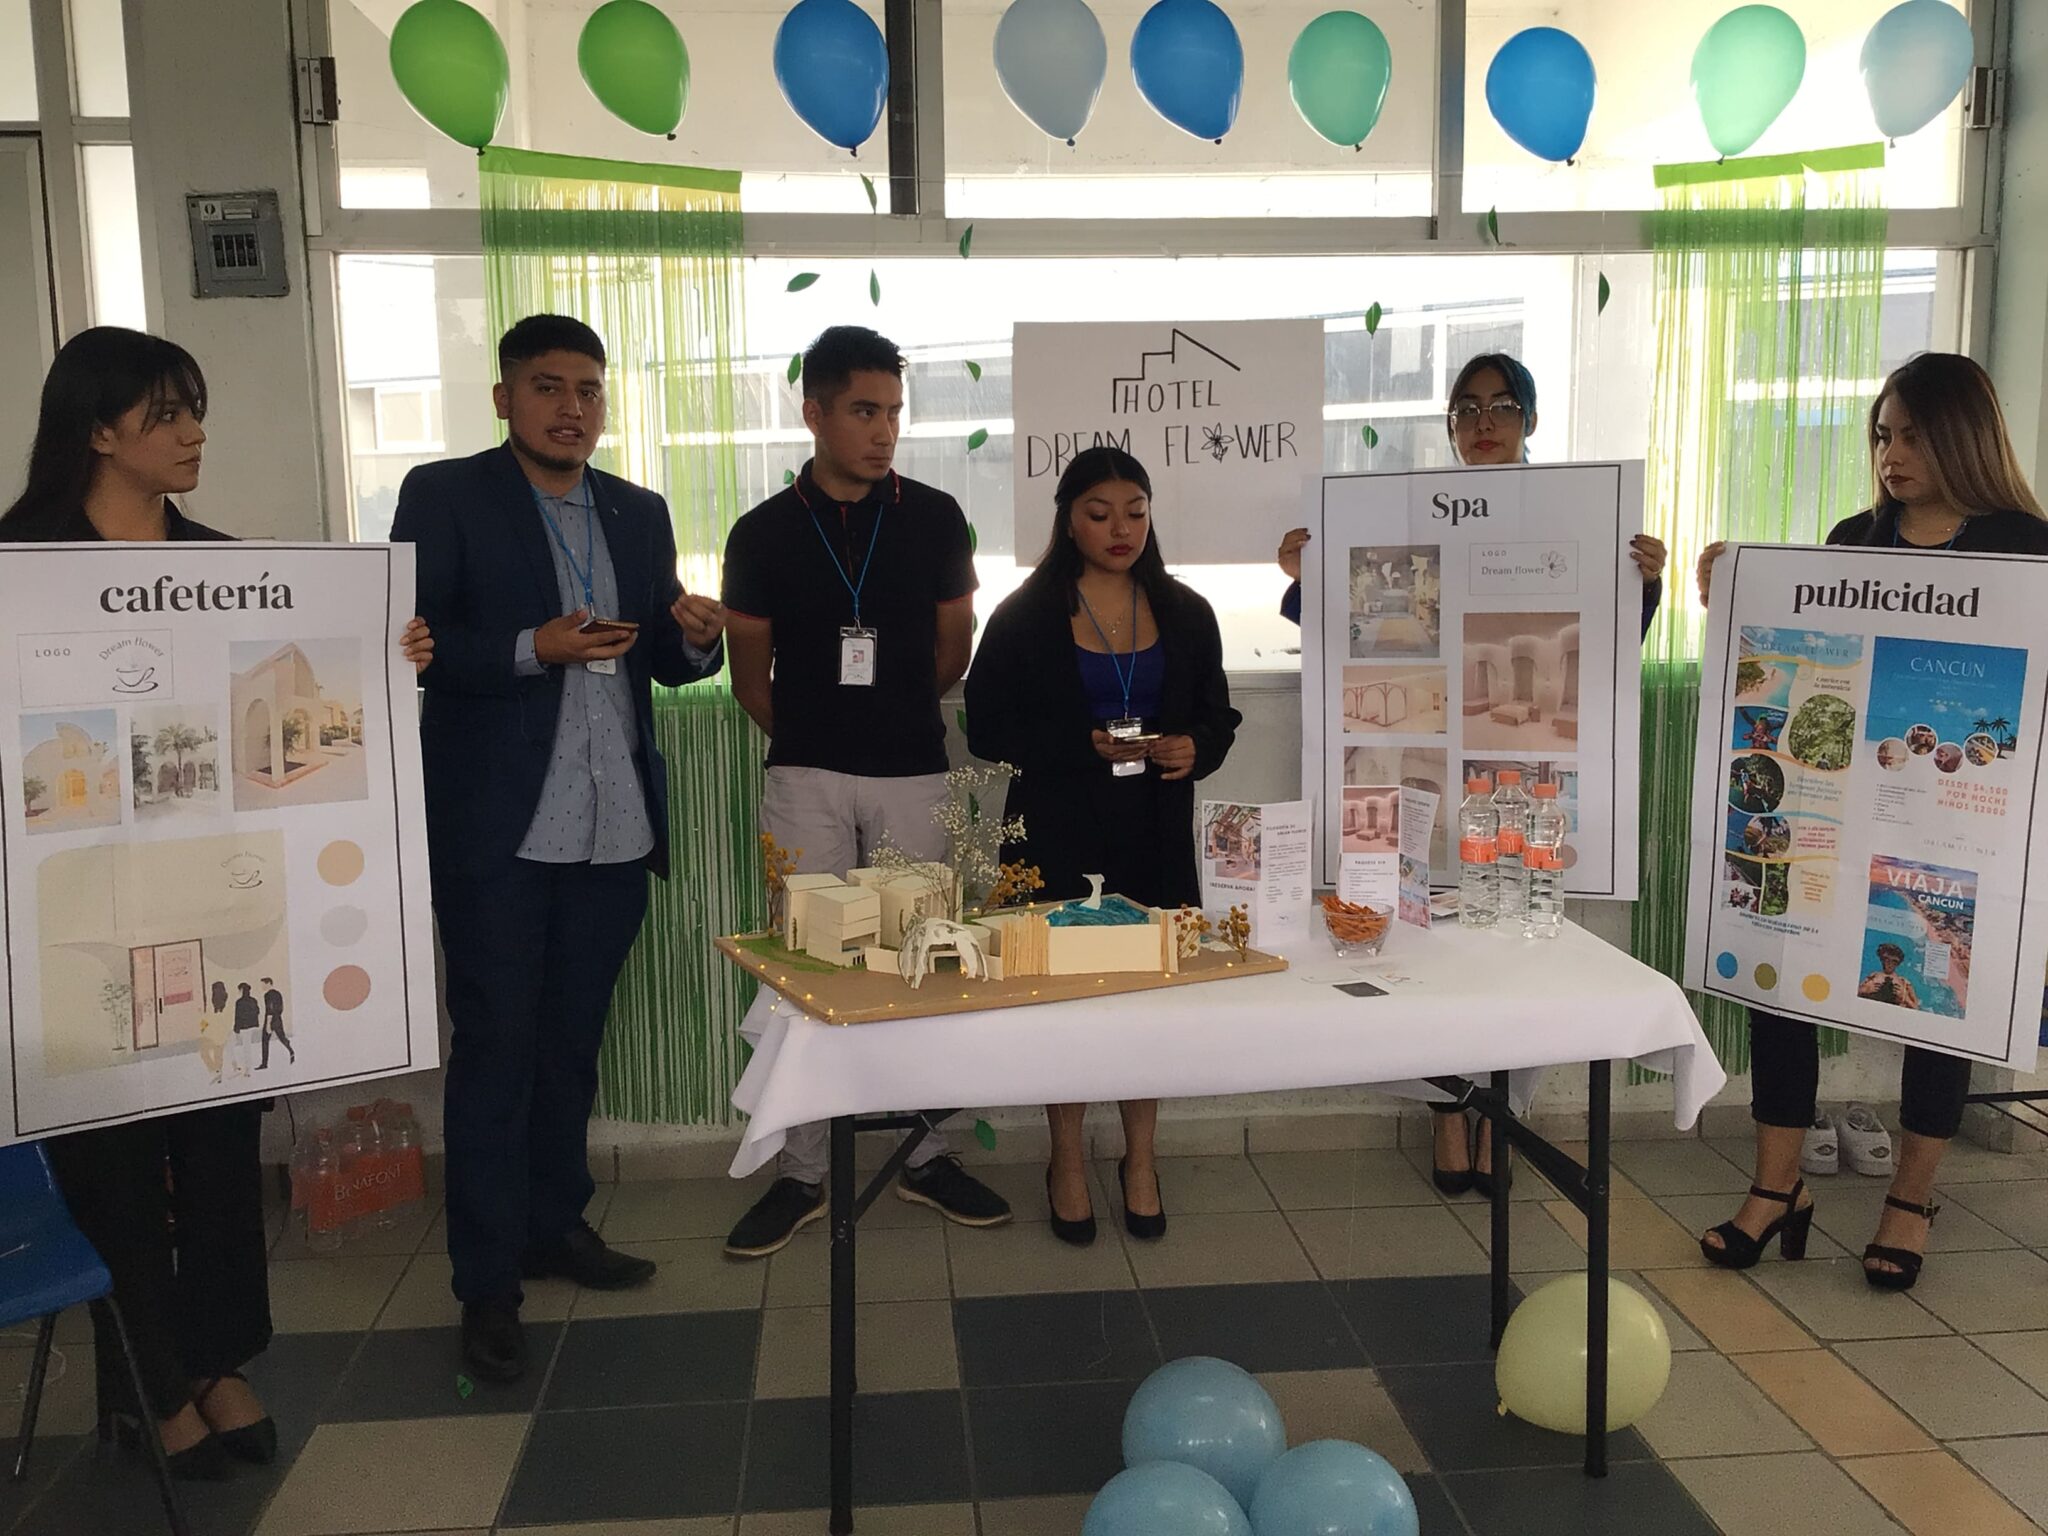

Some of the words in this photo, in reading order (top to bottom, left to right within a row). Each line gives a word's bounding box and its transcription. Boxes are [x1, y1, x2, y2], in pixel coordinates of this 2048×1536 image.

[1124, 379, 1221, 414] HOTEL
[1431, 492, 1490, 526] Spa
[1481, 566, 1512, 575] Dream
[1514, 565, 1545, 575] flower
[99, 571, 295, 613] cafetería
[1792, 578, 1980, 618] publicidad
[35, 648, 71, 657] LOGO
[99, 639, 132, 661] Dream
[135, 636, 165, 658] flower
[1910, 657, 1986, 678] CANCUN
[1937, 779, 1969, 790] DESDE
[1946, 790, 1967, 799] POR
[1971, 793, 2007, 806] NOCHE
[1974, 805, 2006, 817] $2000
[1887, 868, 1964, 899] VIAJA
[1918, 894, 1965, 910] CANCUN
